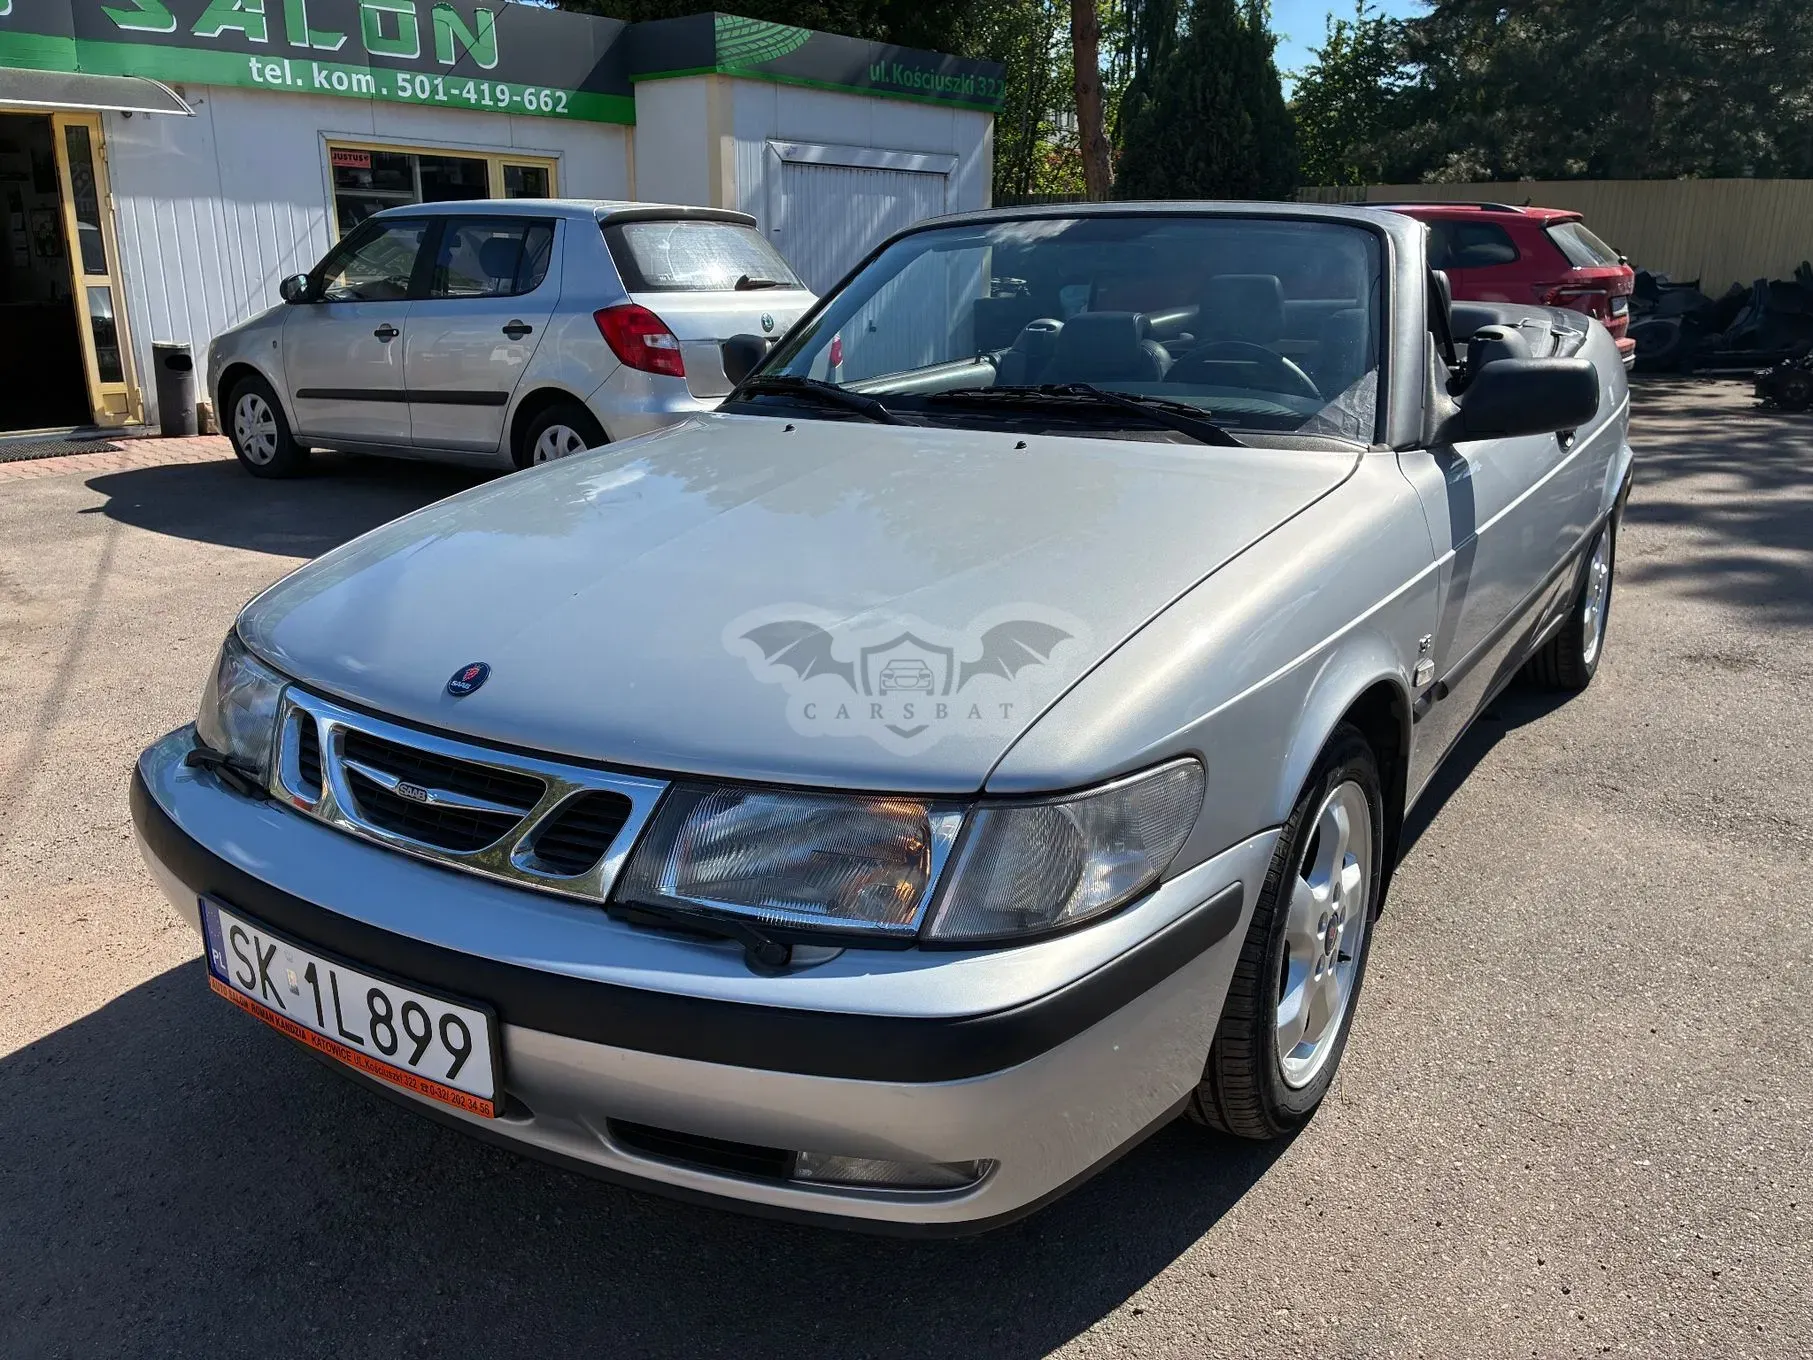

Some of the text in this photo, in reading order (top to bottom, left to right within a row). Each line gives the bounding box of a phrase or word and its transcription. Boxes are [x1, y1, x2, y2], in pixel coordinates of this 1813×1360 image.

[249, 57, 568, 114] tel. kom. 501-419-662
[870, 61, 889, 83] ul.
[893, 63, 974, 95] Kościuszki
[333, 152, 363, 161] JUSTUS
[450, 681, 471, 690] SAAB
[400, 785, 426, 800] SAAB
[212, 947, 226, 970] PL
[229, 925, 472, 1081] SK 1L899
[311, 1034, 352, 1061] KATOWICE
[402, 1074, 418, 1090] 322
[468, 1098, 478, 1111] 34
[480, 1102, 490, 1116] 56
